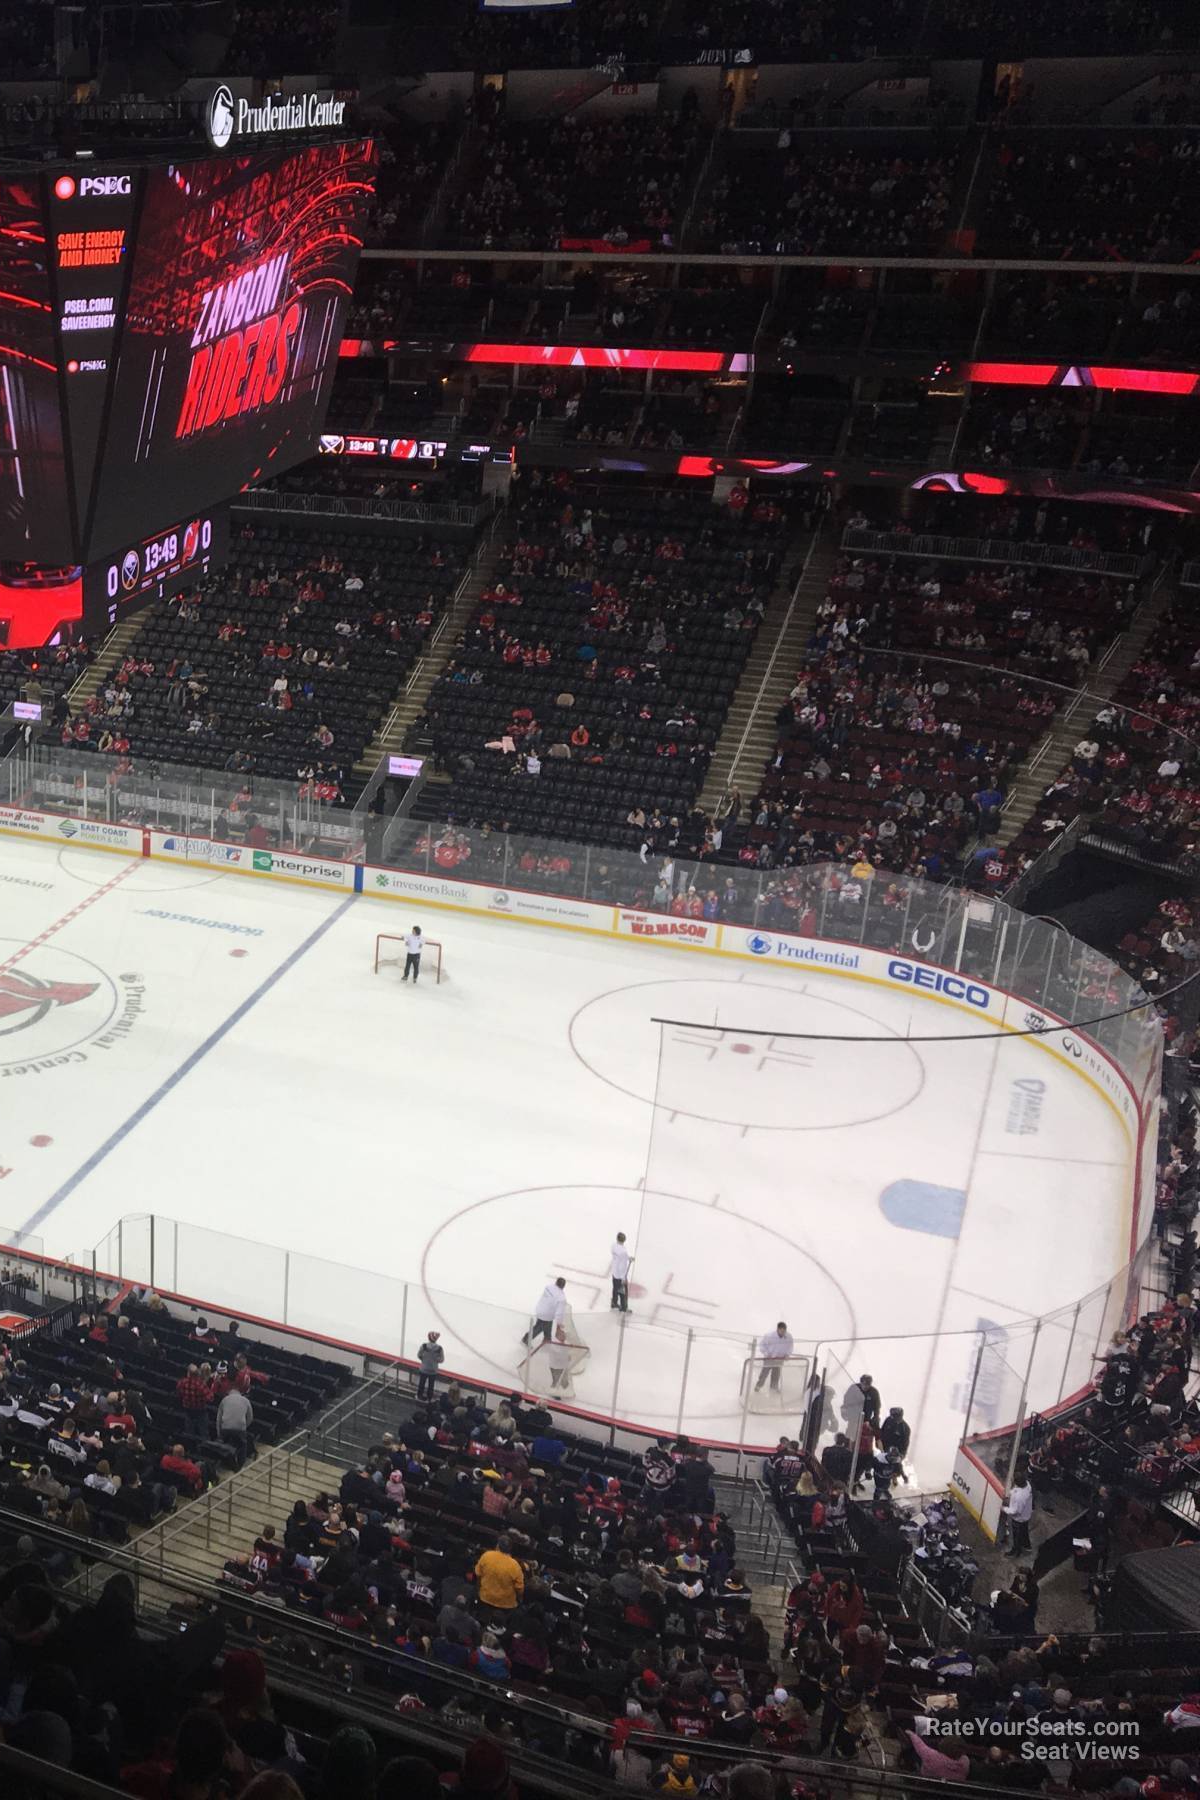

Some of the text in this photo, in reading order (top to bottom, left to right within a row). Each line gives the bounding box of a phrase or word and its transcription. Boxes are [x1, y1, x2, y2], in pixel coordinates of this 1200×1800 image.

[237, 93, 346, 134] Prudential Center
[57, 230, 125, 250] SAVE ENERGY
[60, 247, 122, 267] AND MONEY
[190, 251, 289, 348] ZAMBONI
[61, 314, 116, 331] SAVEENERGY
[175, 302, 300, 440] RIDERS
[350, 440, 375, 452] 13:49
[202, 519, 211, 549] 0
[144, 533, 178, 573] 13:49
[107, 565, 118, 597] 0
[80, 823, 128, 838] EAST COAST
[80, 833, 106, 843] POWER
[174, 839, 228, 860] HALMAR
[260, 855, 343, 878] enterprise
[777, 942, 860, 968] Prudential
[888, 960, 990, 1008] GEICO
[1, 985, 147, 1078] Prudential Center
